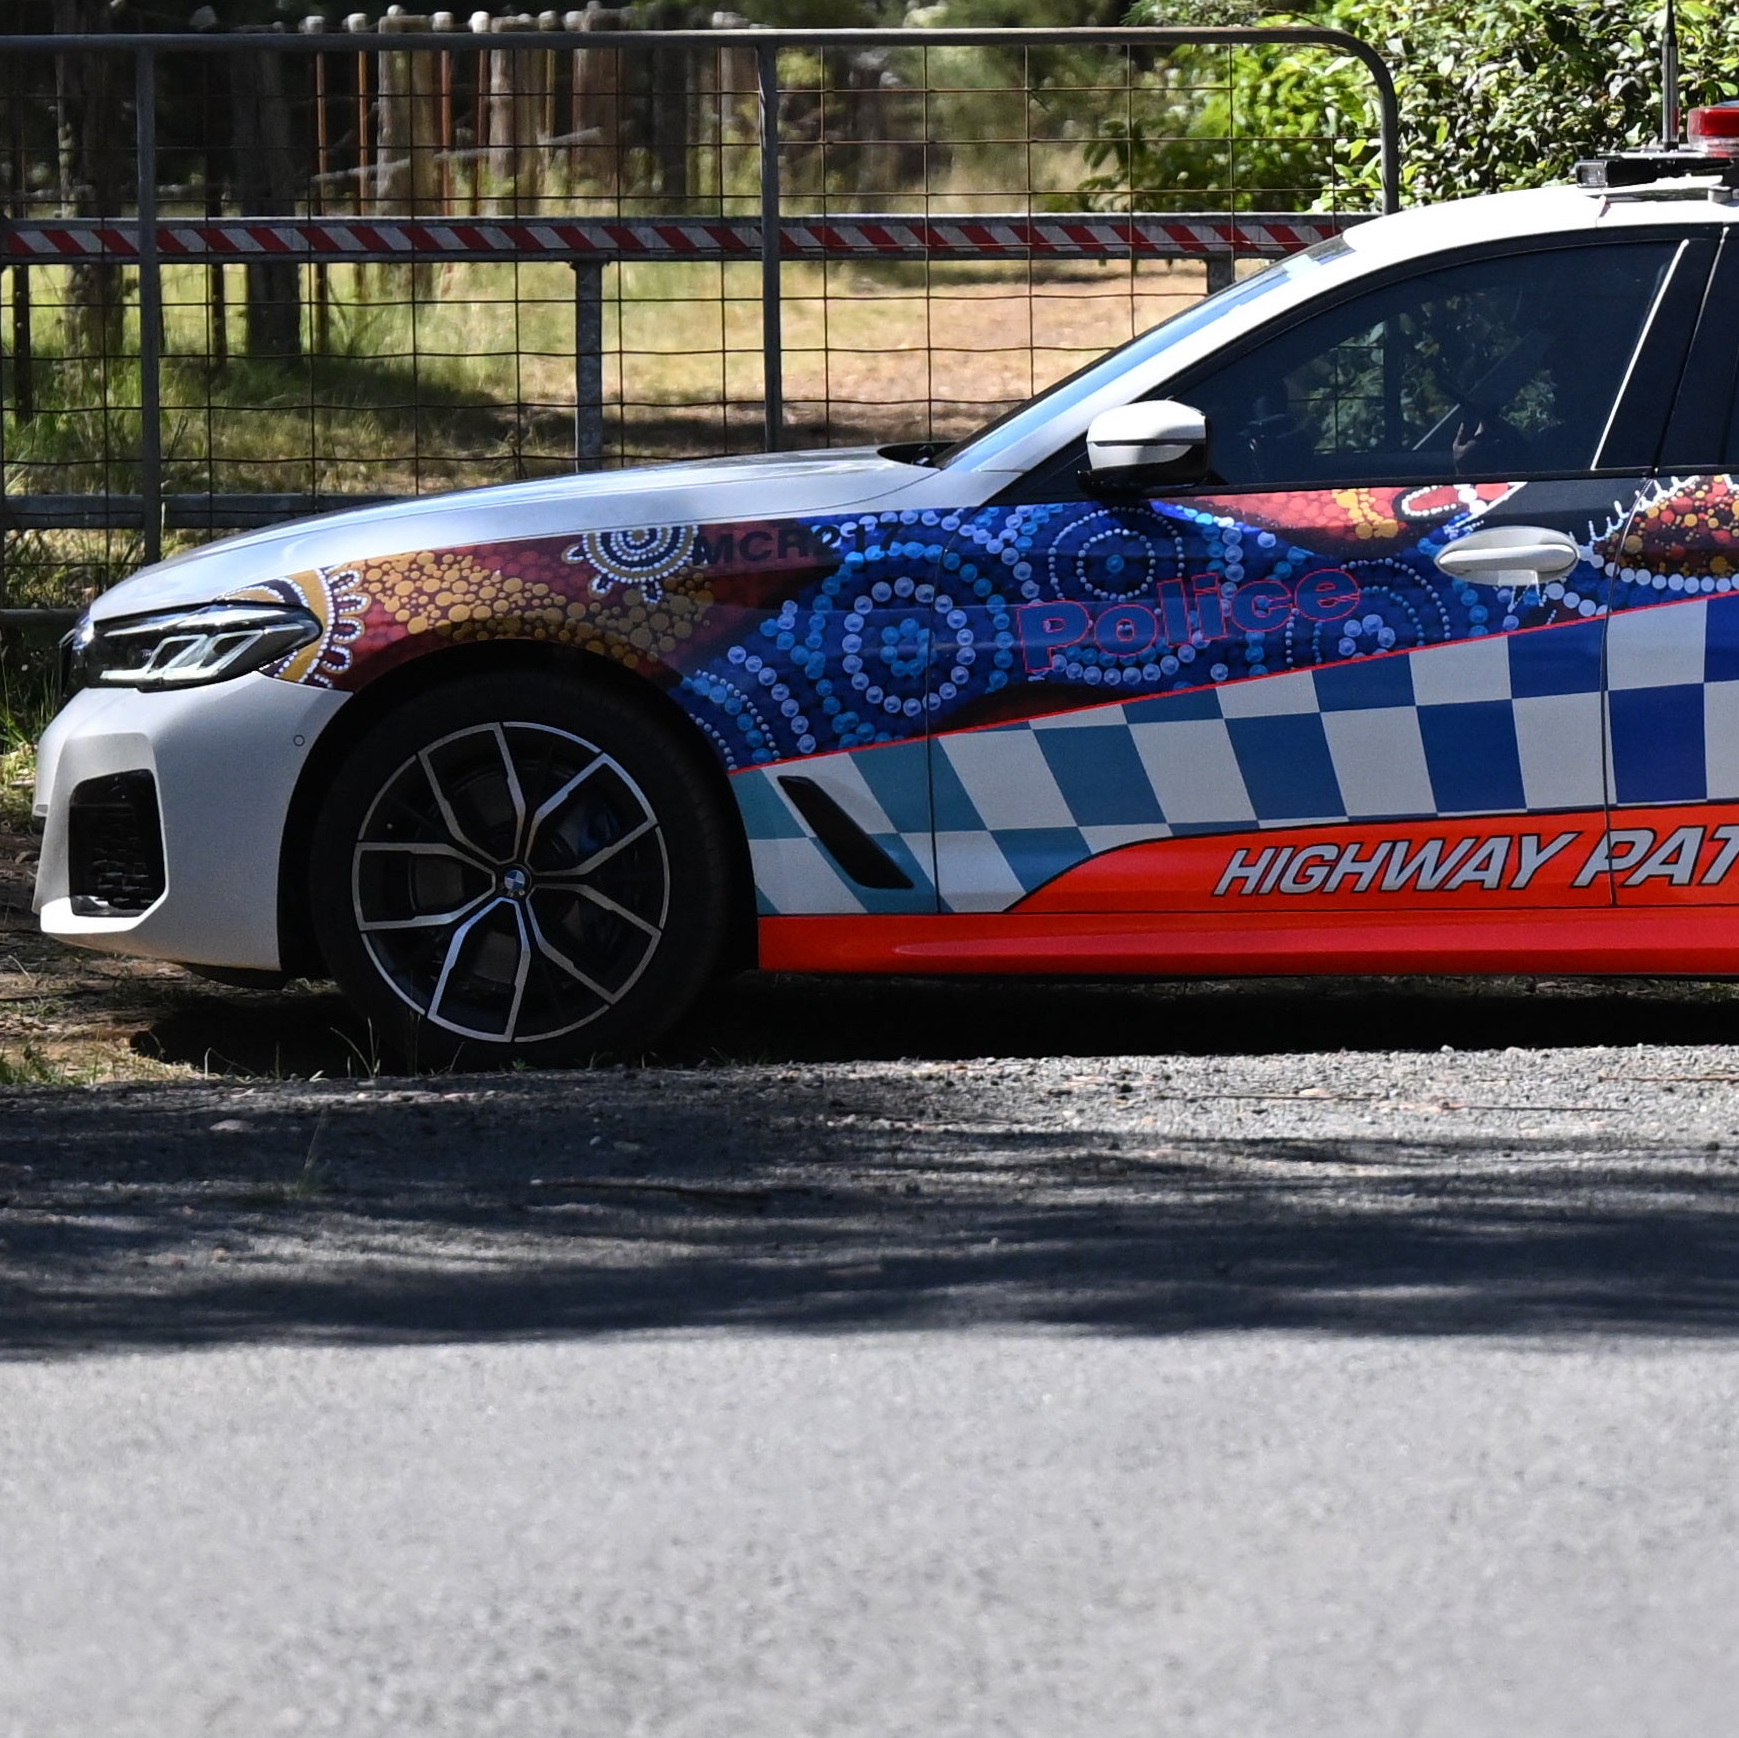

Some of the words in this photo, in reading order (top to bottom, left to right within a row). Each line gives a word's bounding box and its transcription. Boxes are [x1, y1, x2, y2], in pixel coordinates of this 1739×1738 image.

[690, 522, 902, 566] MCR217
[1017, 568, 1360, 673] Police
[1212, 831, 1583, 897] HIGHWAY
